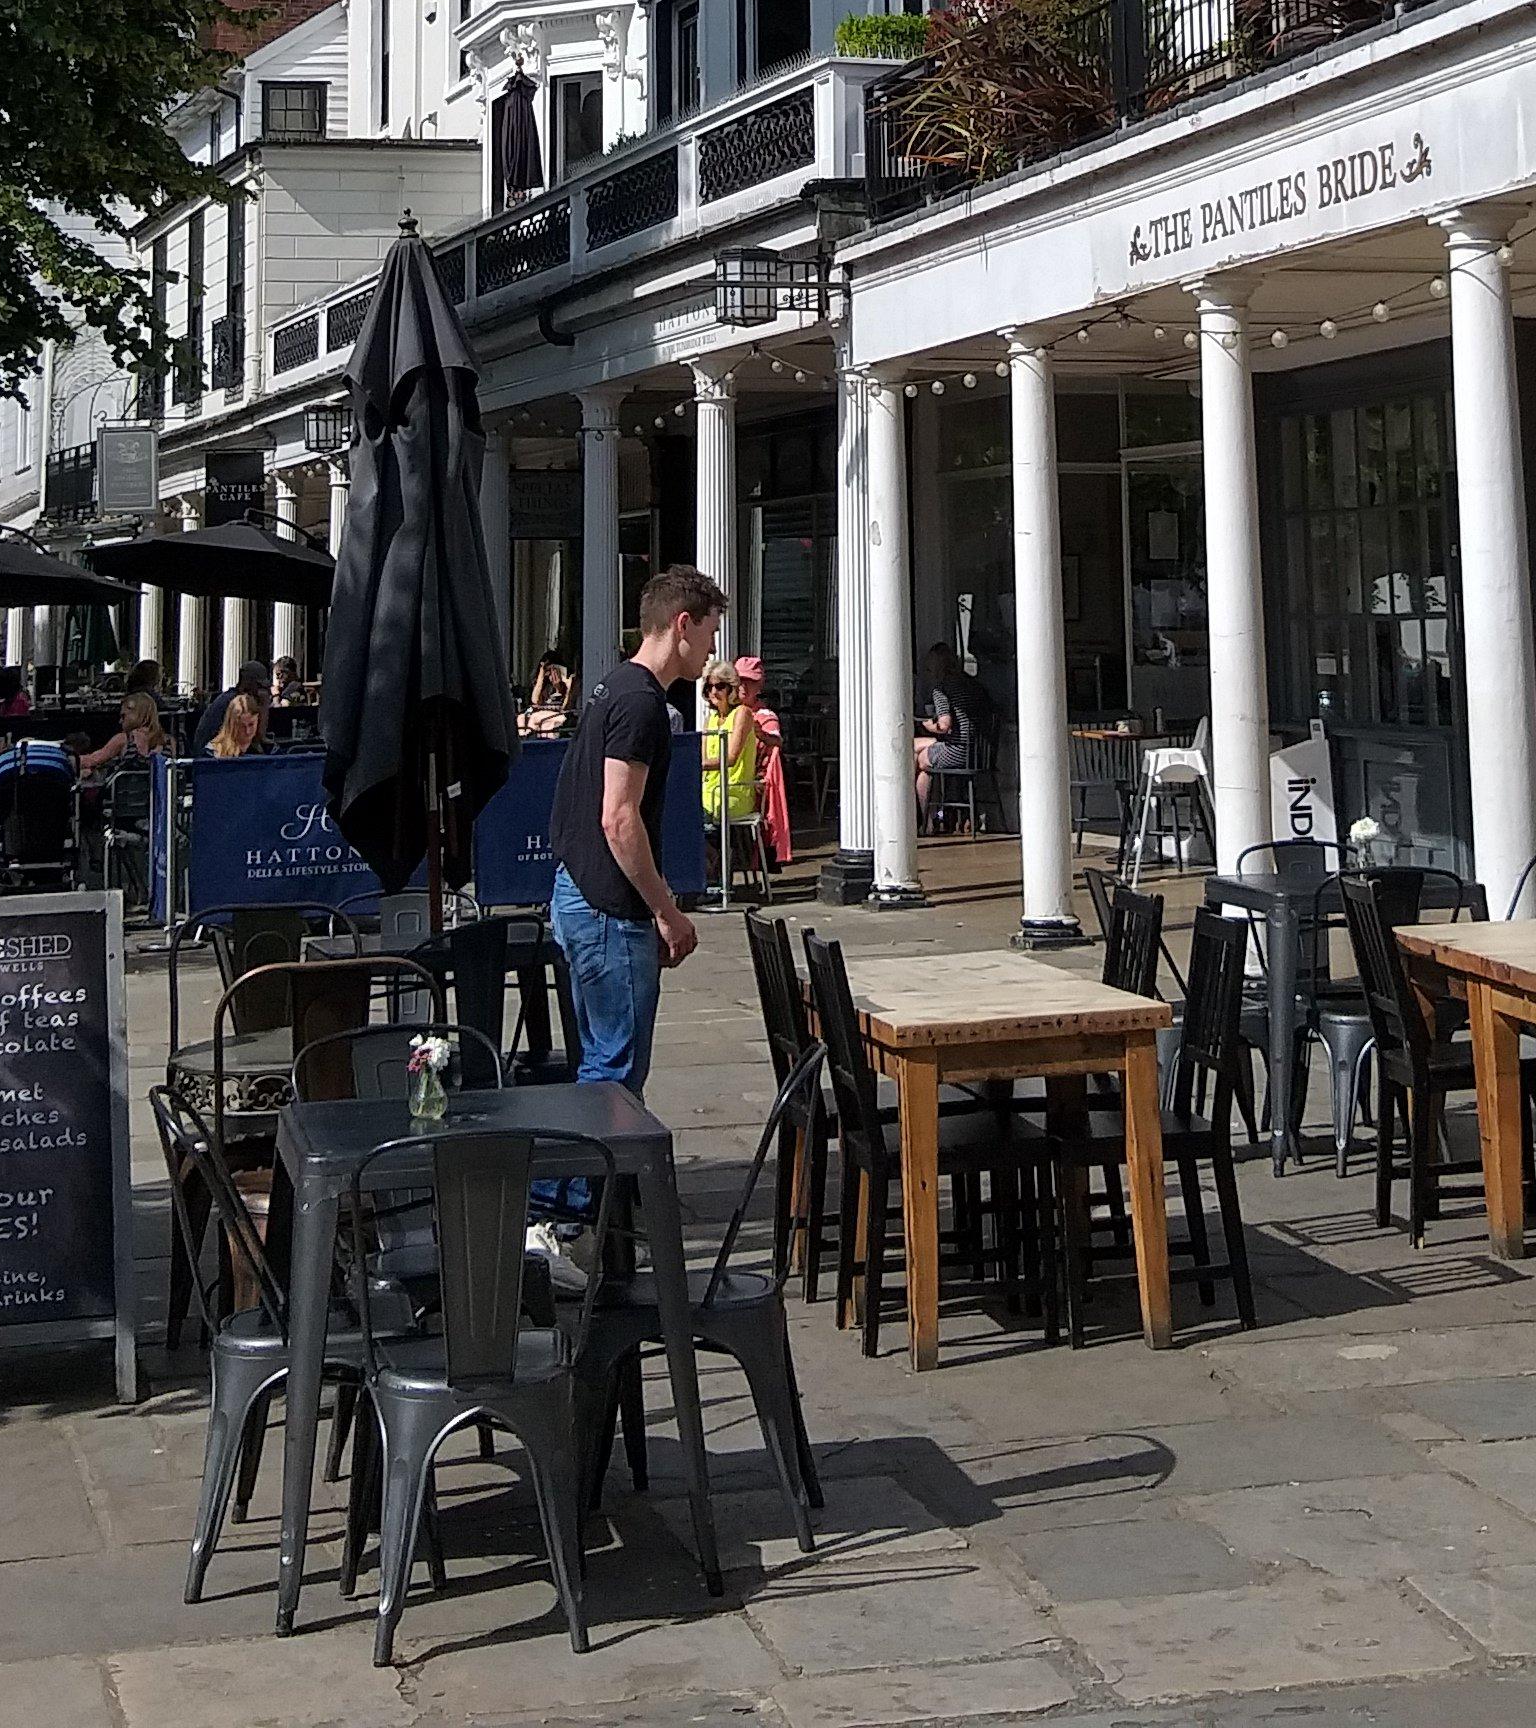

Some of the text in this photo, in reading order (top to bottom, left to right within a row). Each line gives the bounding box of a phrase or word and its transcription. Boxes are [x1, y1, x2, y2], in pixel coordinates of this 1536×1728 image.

[1148, 141, 1397, 259] THE PANTILES BRIDE
[219, 493, 252, 501] CAFE
[1288, 777, 1317, 840] iND
[246, 845, 363, 865] HATTON
[533, 852, 553, 860] ROY
[247, 862, 372, 879] DELI & LIFESTYLE STOR
[0, 961, 44, 974] WELLS
[23, 1011, 79, 1030] teas
